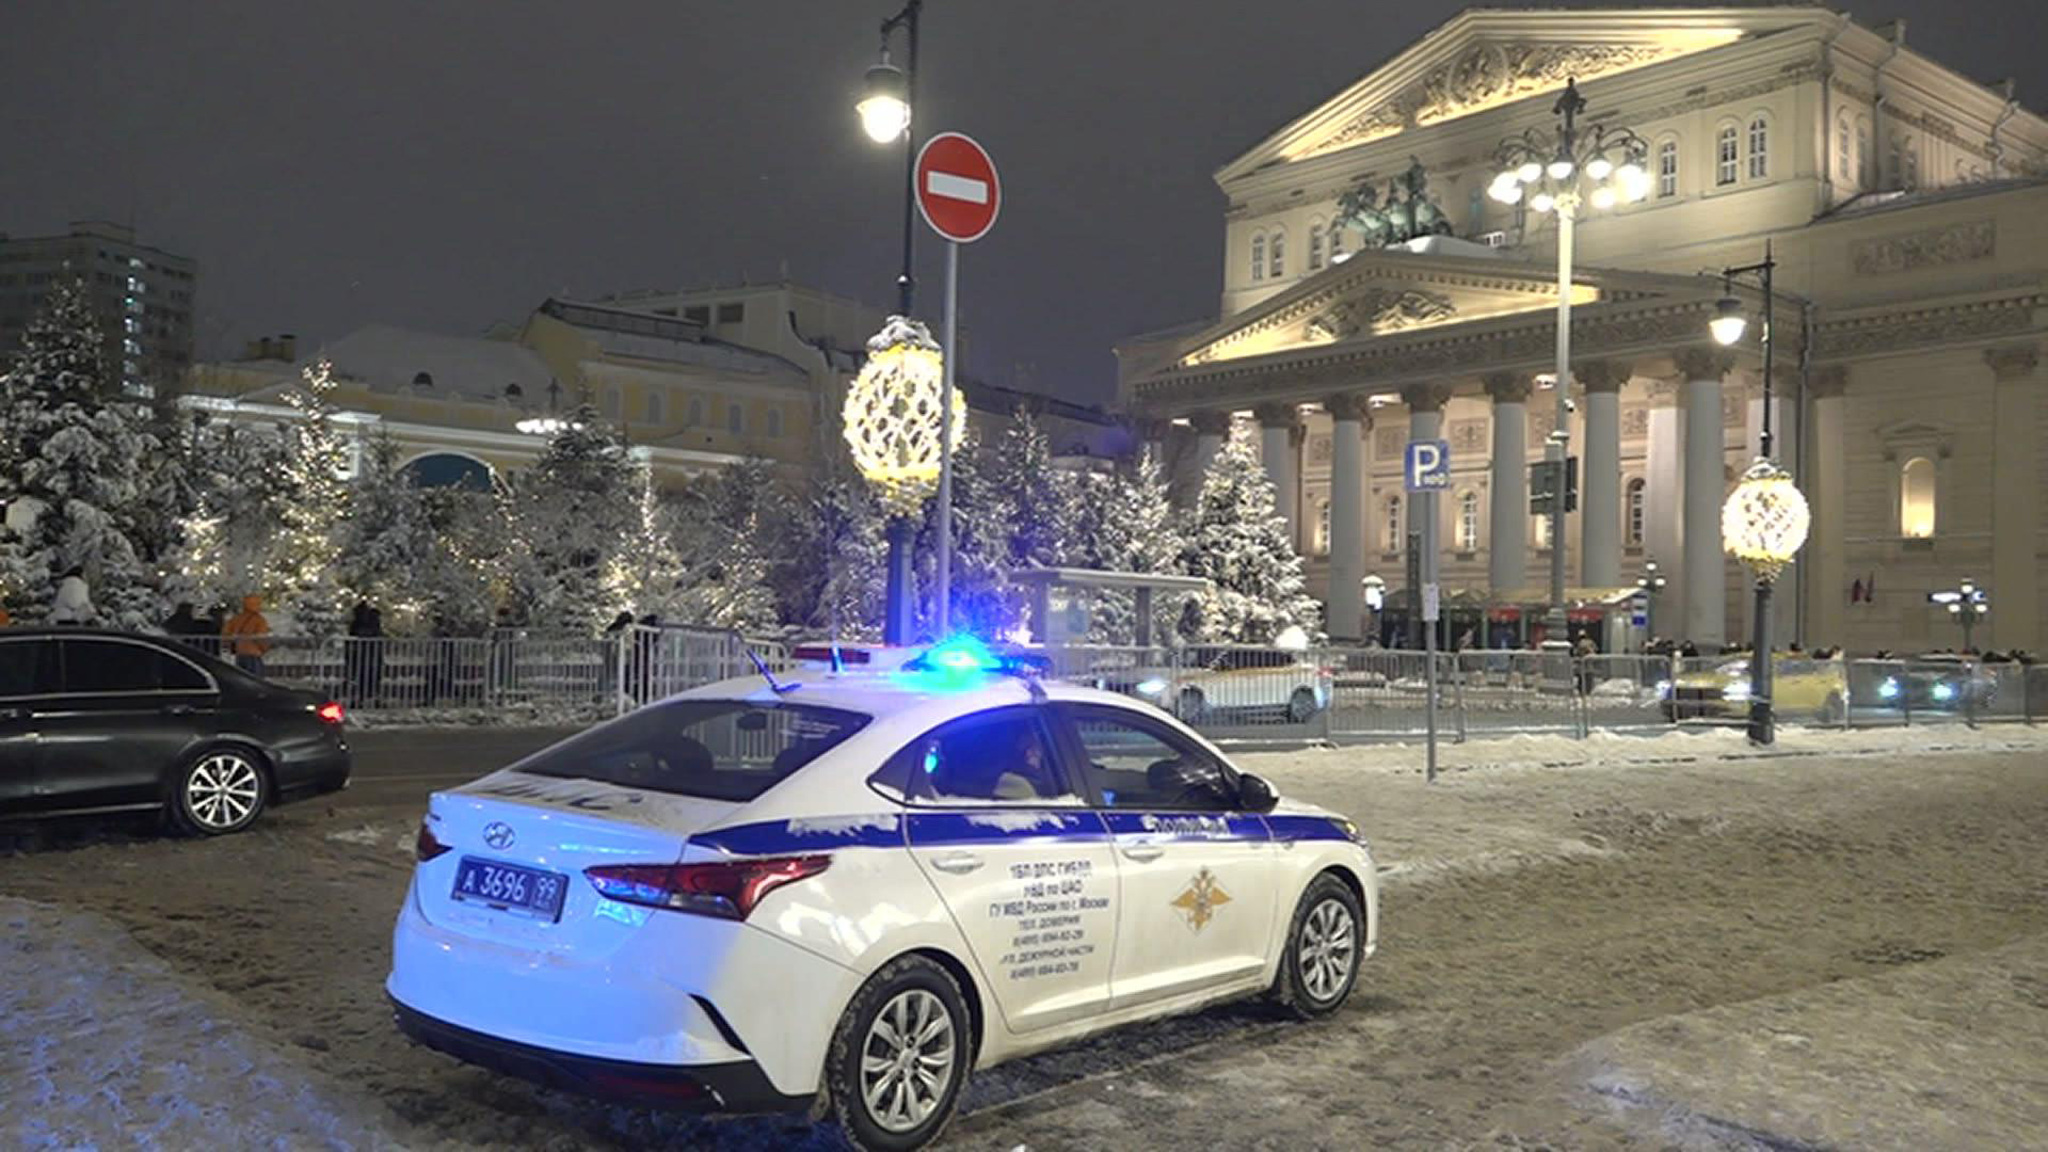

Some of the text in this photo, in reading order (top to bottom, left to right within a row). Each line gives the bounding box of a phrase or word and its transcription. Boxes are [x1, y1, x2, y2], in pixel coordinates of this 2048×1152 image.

[1414, 446, 1439, 486] P
[463, 867, 558, 901] А 3696 99
